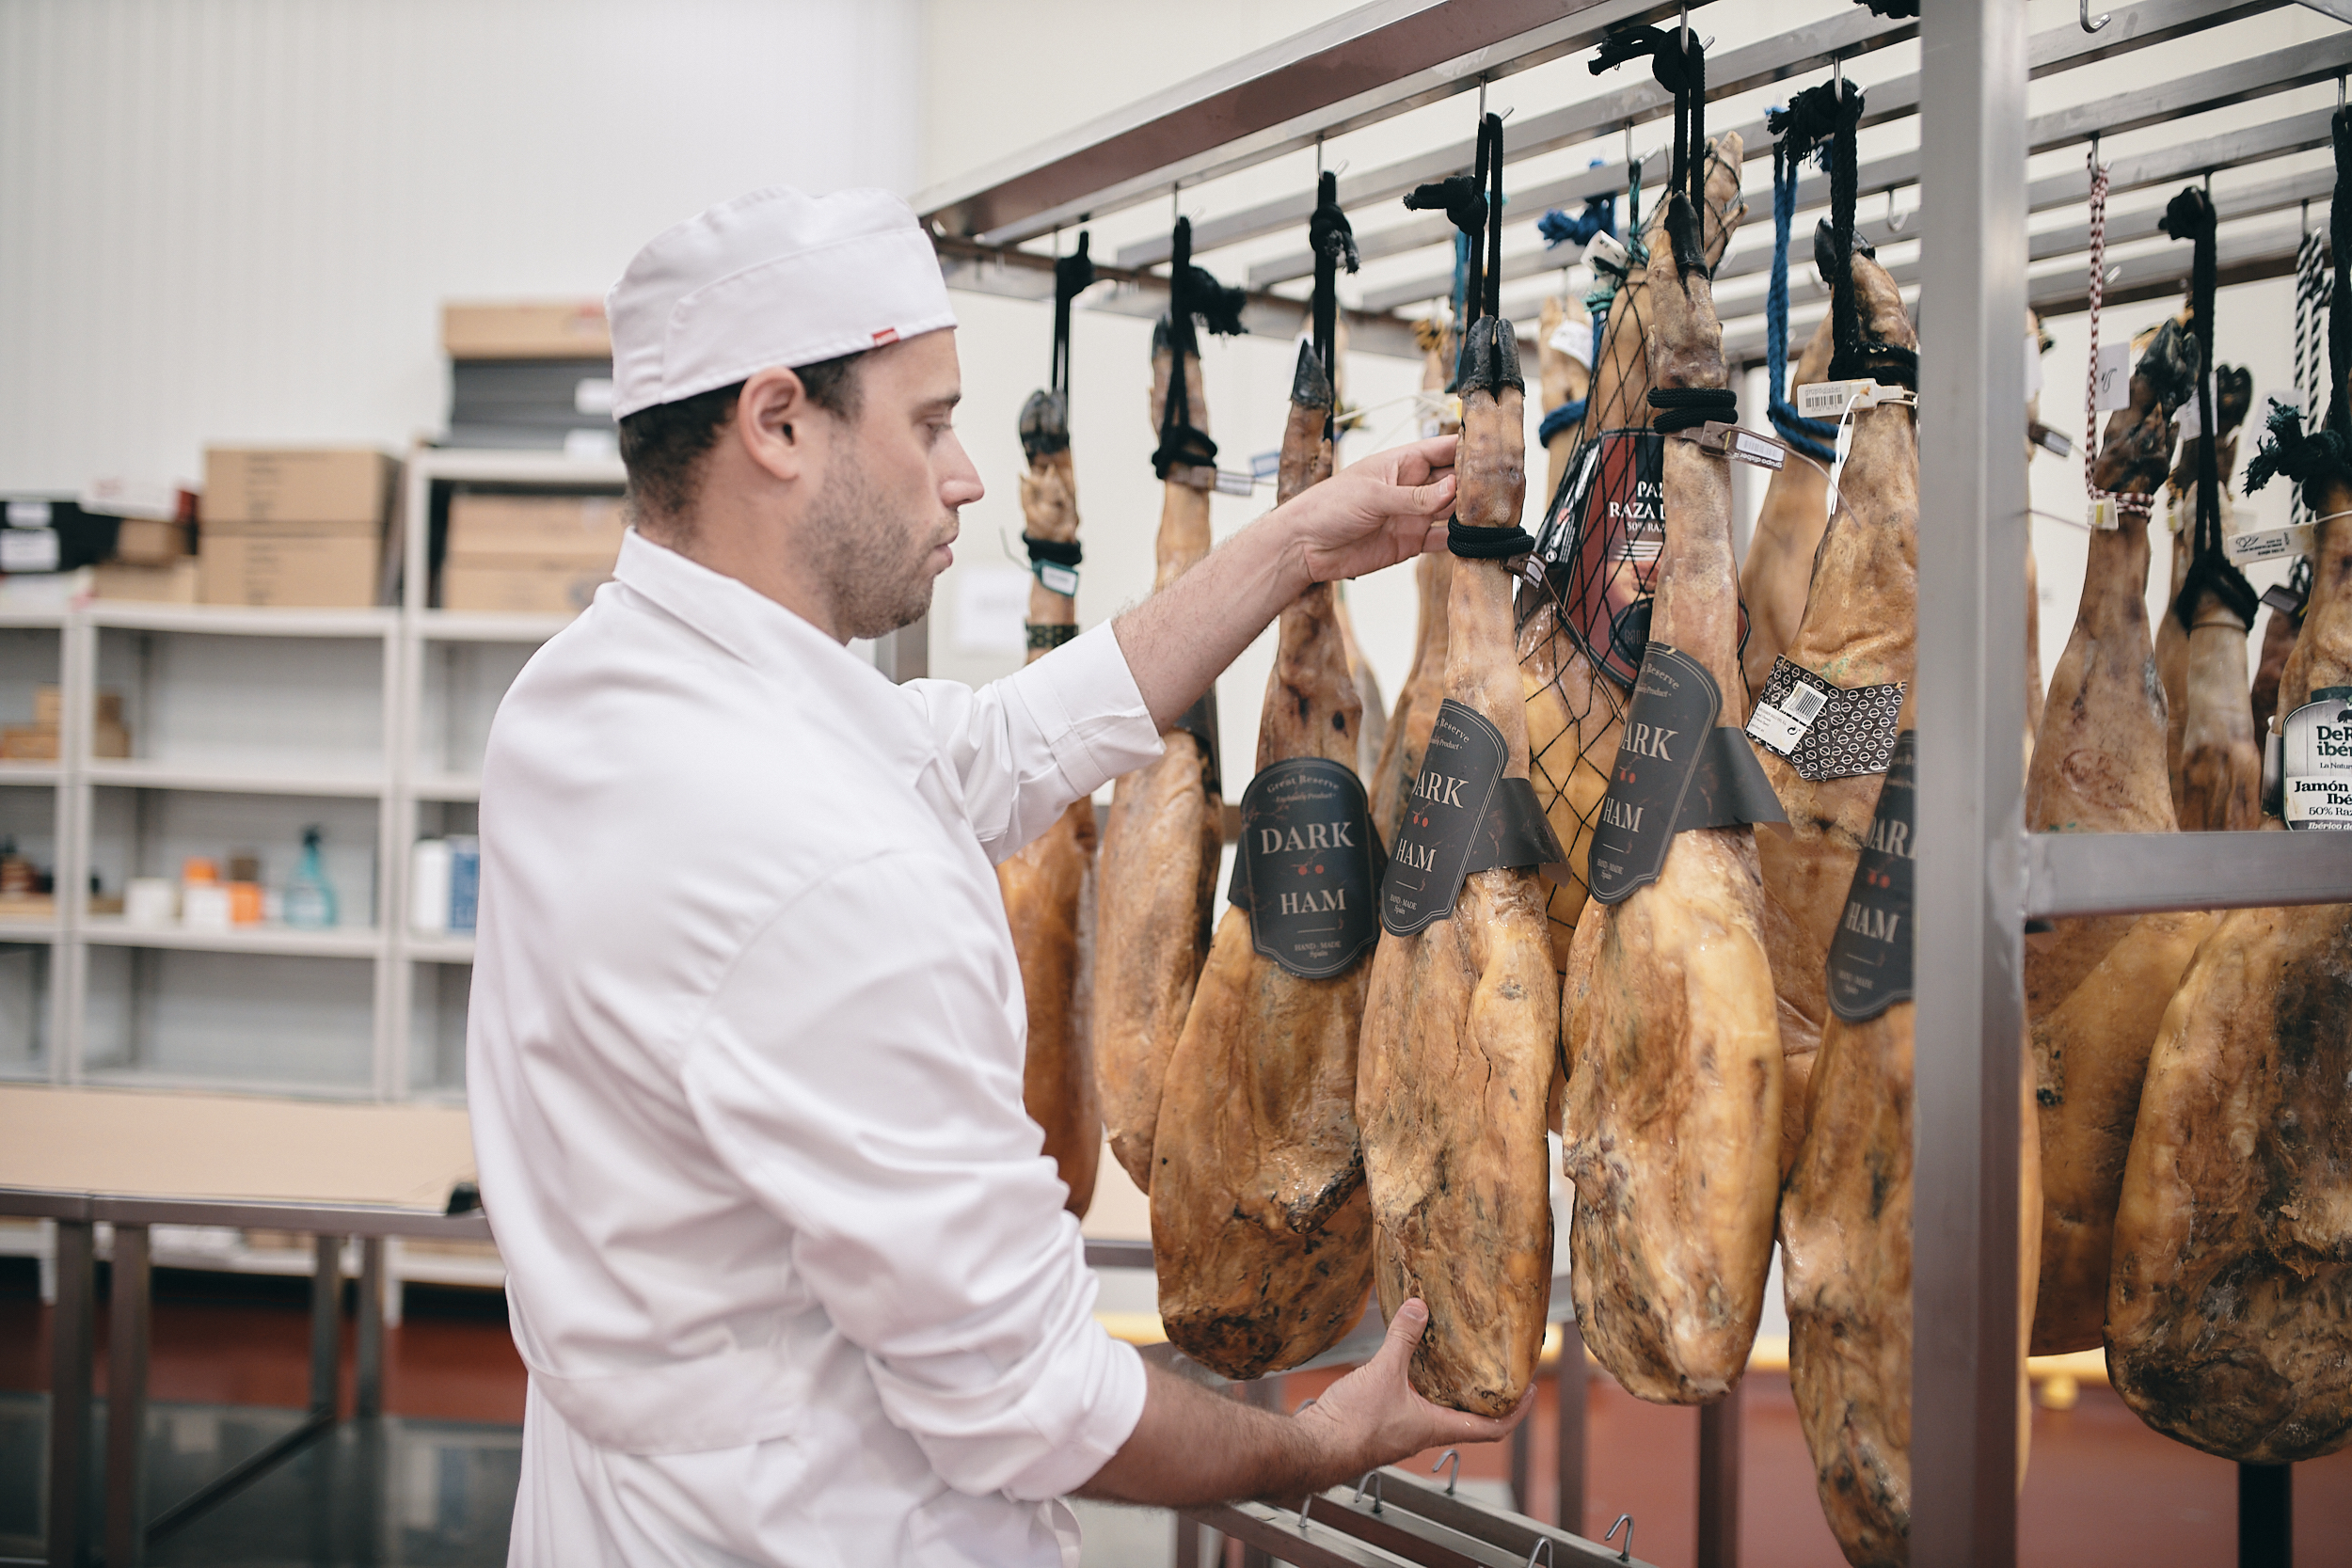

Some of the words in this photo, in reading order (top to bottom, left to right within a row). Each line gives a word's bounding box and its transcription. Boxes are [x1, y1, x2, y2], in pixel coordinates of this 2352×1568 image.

[1609, 501, 1656, 519] RAZA
[1646, 663, 1679, 689] Reserve
[1439, 718, 1470, 743] Reserve
[1619, 721, 1678, 762] ARK
[1412, 768, 1469, 808] ARK
[2295, 781, 2348, 792] Jamón
[1602, 797, 1645, 832] HAM
[2309, 807, 2333, 816] 50%
[1260, 821, 1355, 854] DARK
[2308, 822, 2343, 831] Ibérico
[1395, 838, 1437, 872] HAM
[1279, 888, 1347, 915] HAM
[1845, 900, 1900, 942] HAM
